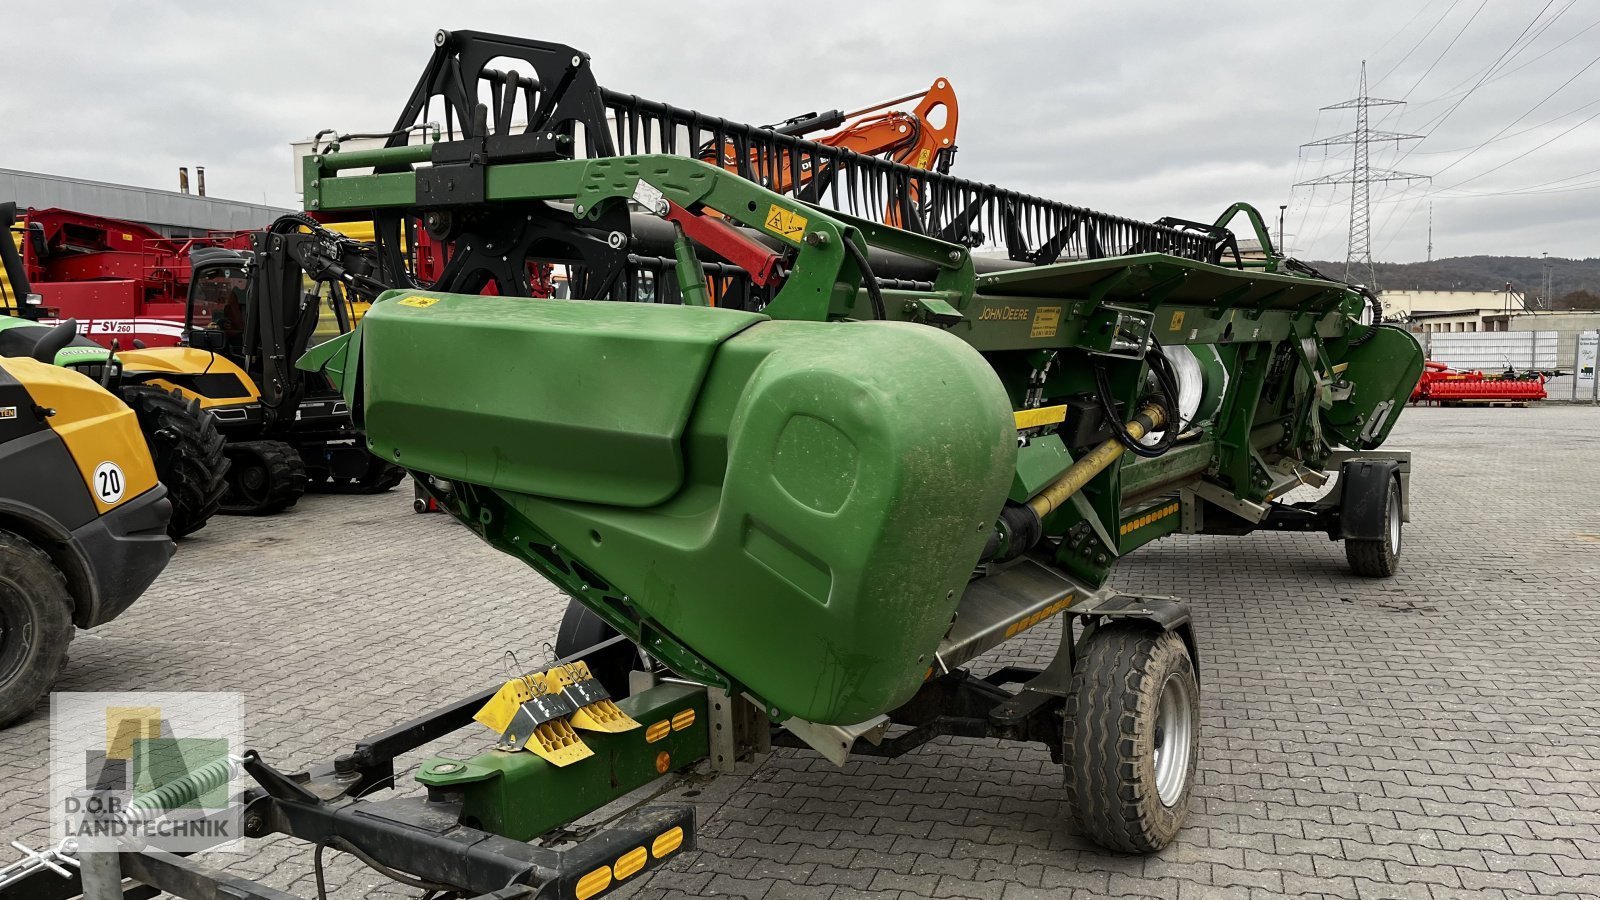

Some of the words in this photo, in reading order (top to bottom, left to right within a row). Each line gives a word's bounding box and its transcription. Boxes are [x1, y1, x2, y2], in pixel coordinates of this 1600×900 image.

[979, 306, 1001, 320] JOHN
[1002, 306, 1029, 320] DEERE
[102, 321, 117, 332] SV
[117, 325, 131, 333] 260
[99, 469, 120, 497] 20
